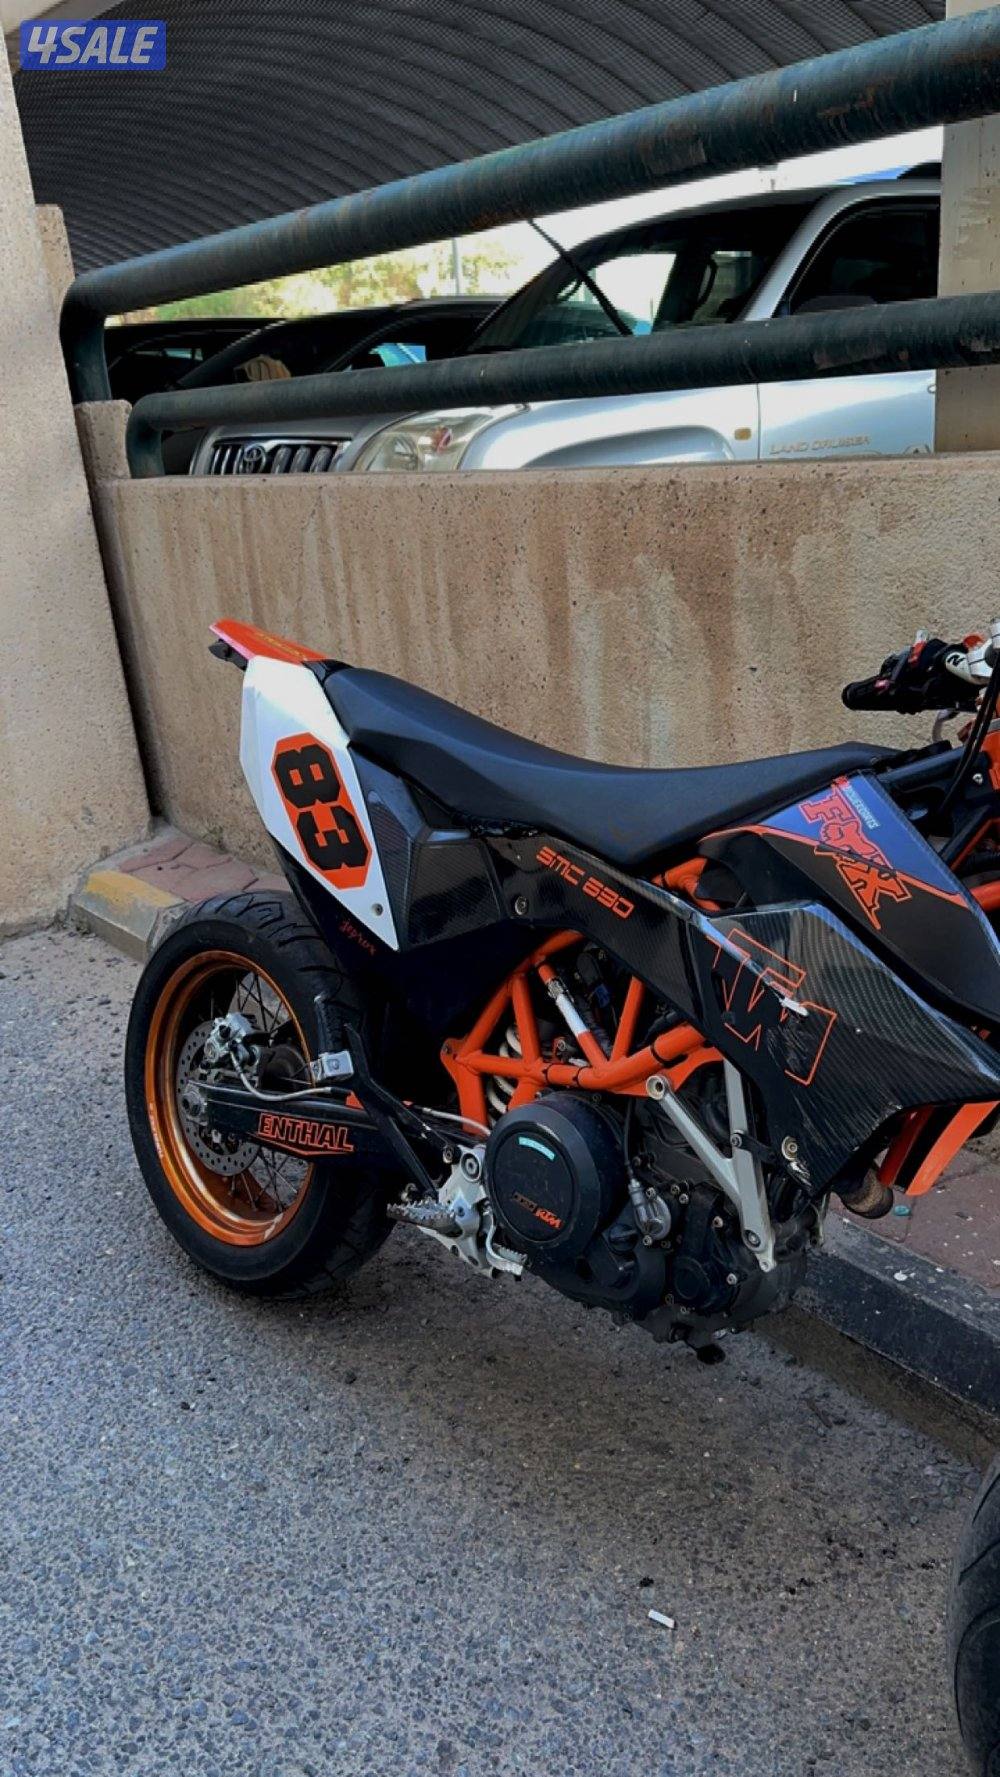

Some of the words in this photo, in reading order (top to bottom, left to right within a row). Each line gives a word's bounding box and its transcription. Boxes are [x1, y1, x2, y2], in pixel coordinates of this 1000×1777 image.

[769, 441, 809, 455] LAND
[274, 743, 370, 870] 83
[536, 845, 586, 886] SMC
[582, 876, 636, 919] 690
[257, 1112, 354, 1152] ENTHAL
